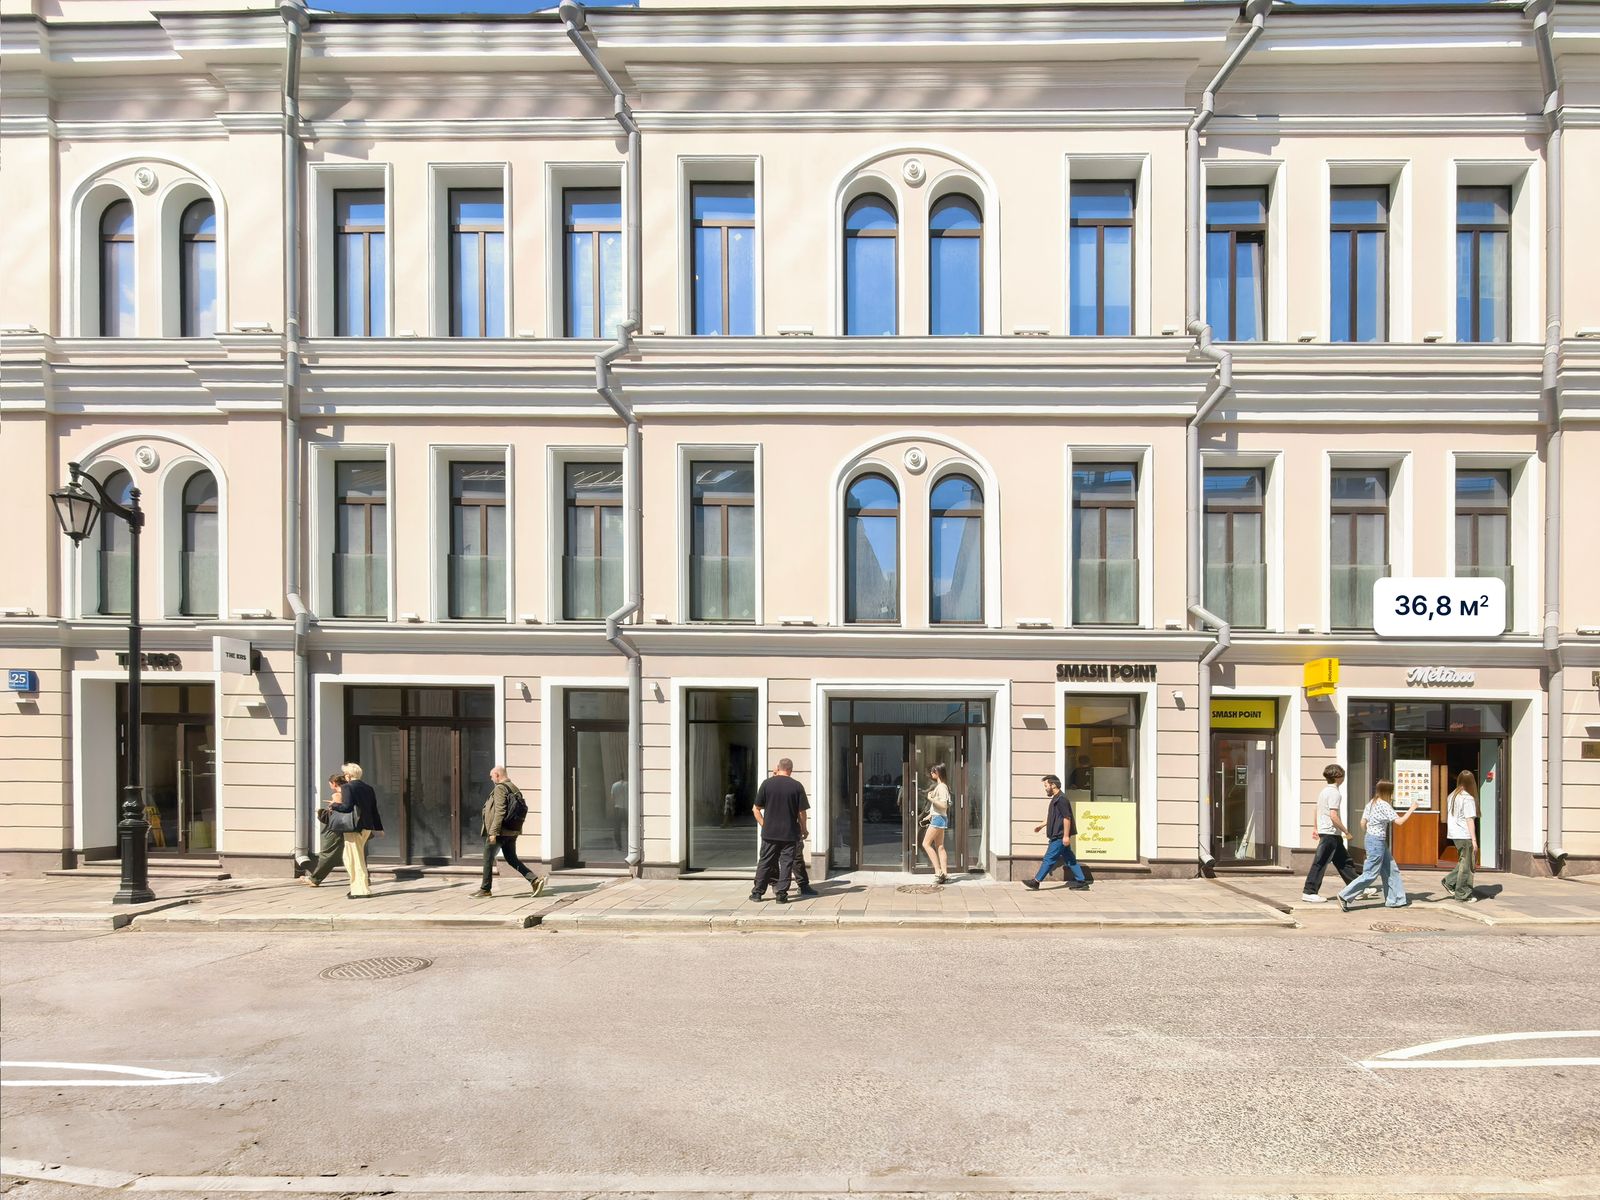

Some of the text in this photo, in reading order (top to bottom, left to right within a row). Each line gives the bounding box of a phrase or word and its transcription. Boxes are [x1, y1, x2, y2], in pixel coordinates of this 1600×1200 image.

[1056, 664, 1107, 678] SMASH
[11, 673, 26, 684] 25
[1211, 710, 1238, 718] SMASH
